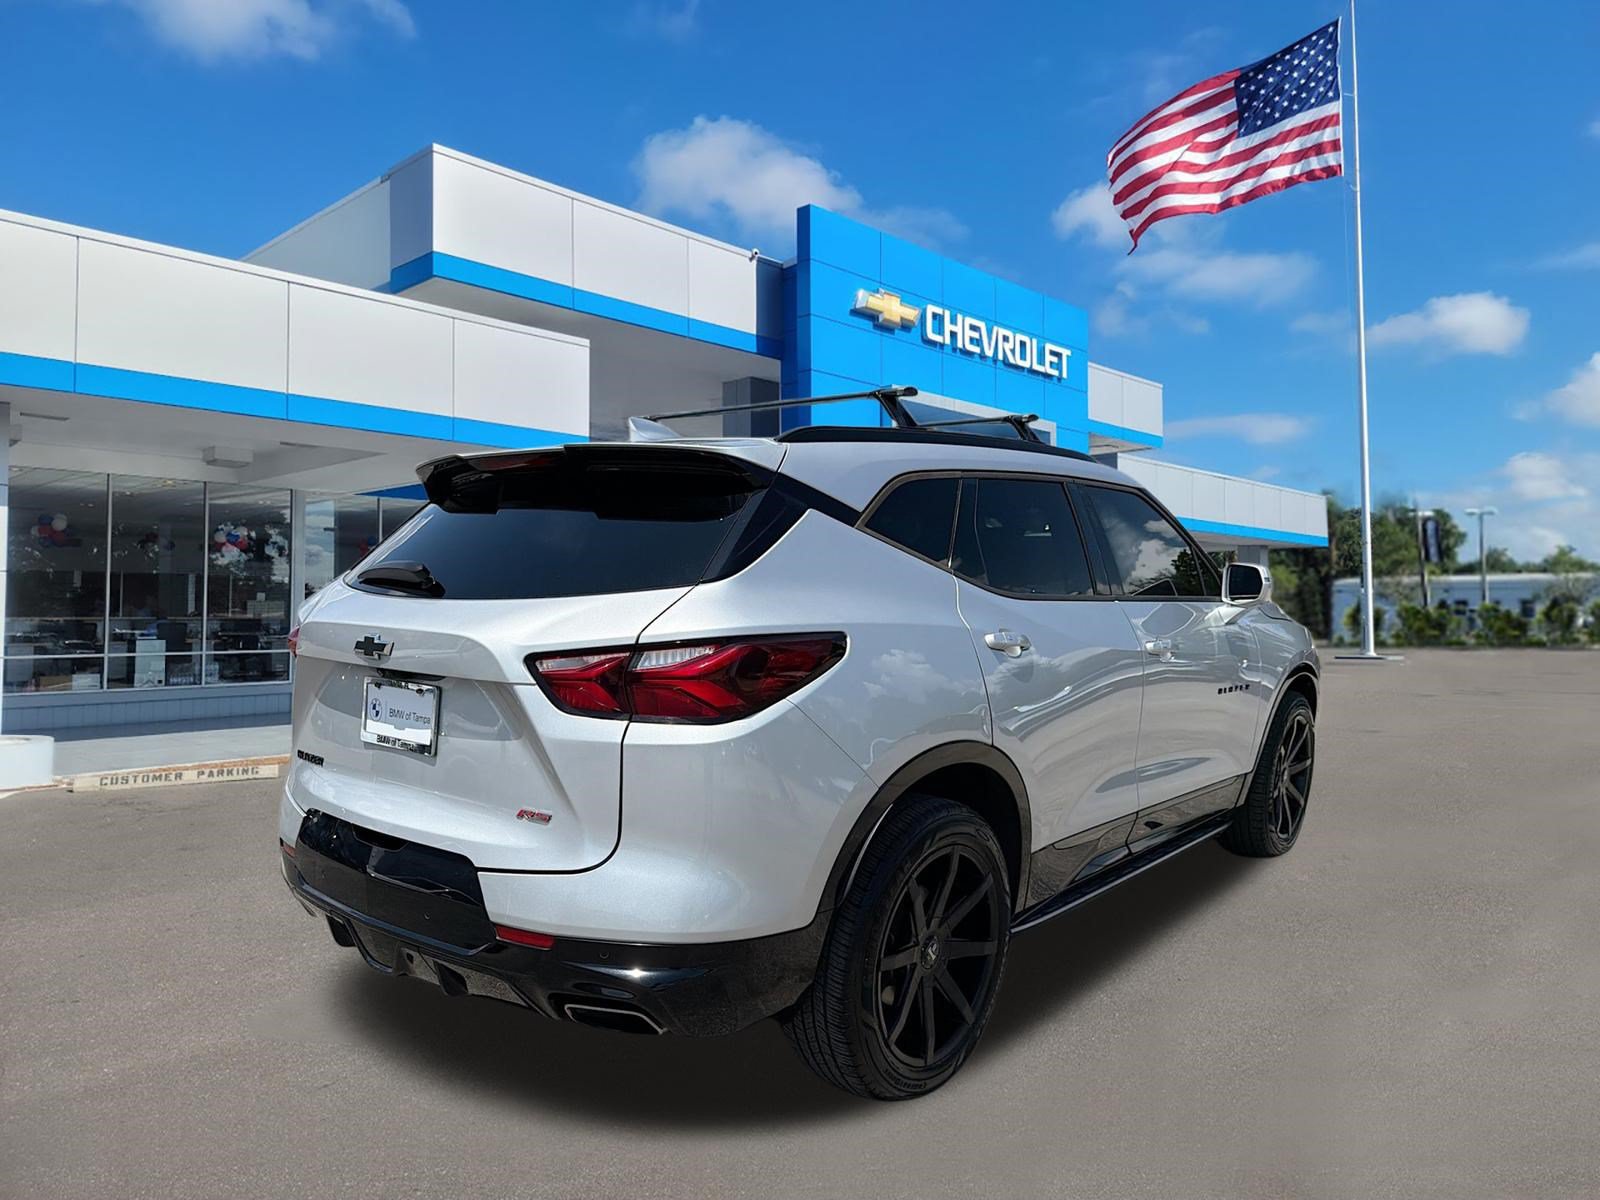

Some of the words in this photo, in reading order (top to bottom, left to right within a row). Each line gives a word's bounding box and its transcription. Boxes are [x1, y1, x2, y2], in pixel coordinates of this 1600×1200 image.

[925, 303, 1072, 379] CHEVROLET
[389, 707, 405, 719] BMW
[412, 711, 431, 725] Tampa
[376, 734, 390, 745] BMW
[99, 772, 183, 786] CUSTOMER
[197, 767, 259, 779] PARKING
[516, 808, 552, 825] RS
